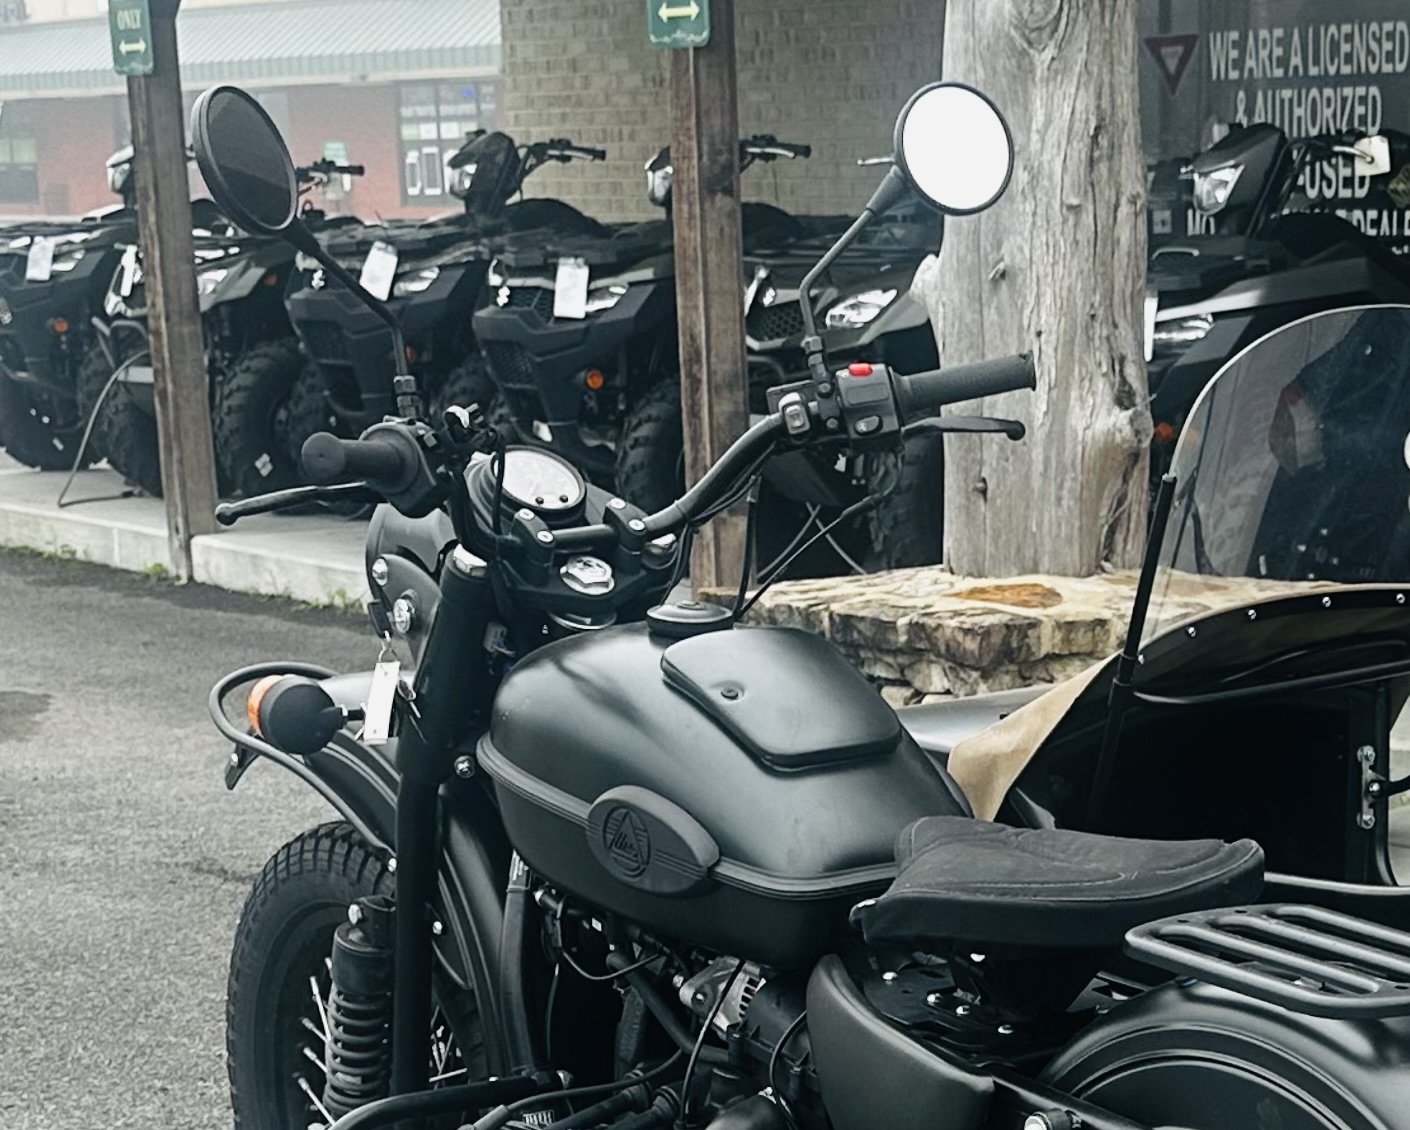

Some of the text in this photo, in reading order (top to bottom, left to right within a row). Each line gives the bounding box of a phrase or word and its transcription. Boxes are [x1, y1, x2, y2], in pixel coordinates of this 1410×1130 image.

[1209, 20, 1409, 80] WE ARE A LICENSED
[1253, 85, 1382, 138] AUTHORIZED
